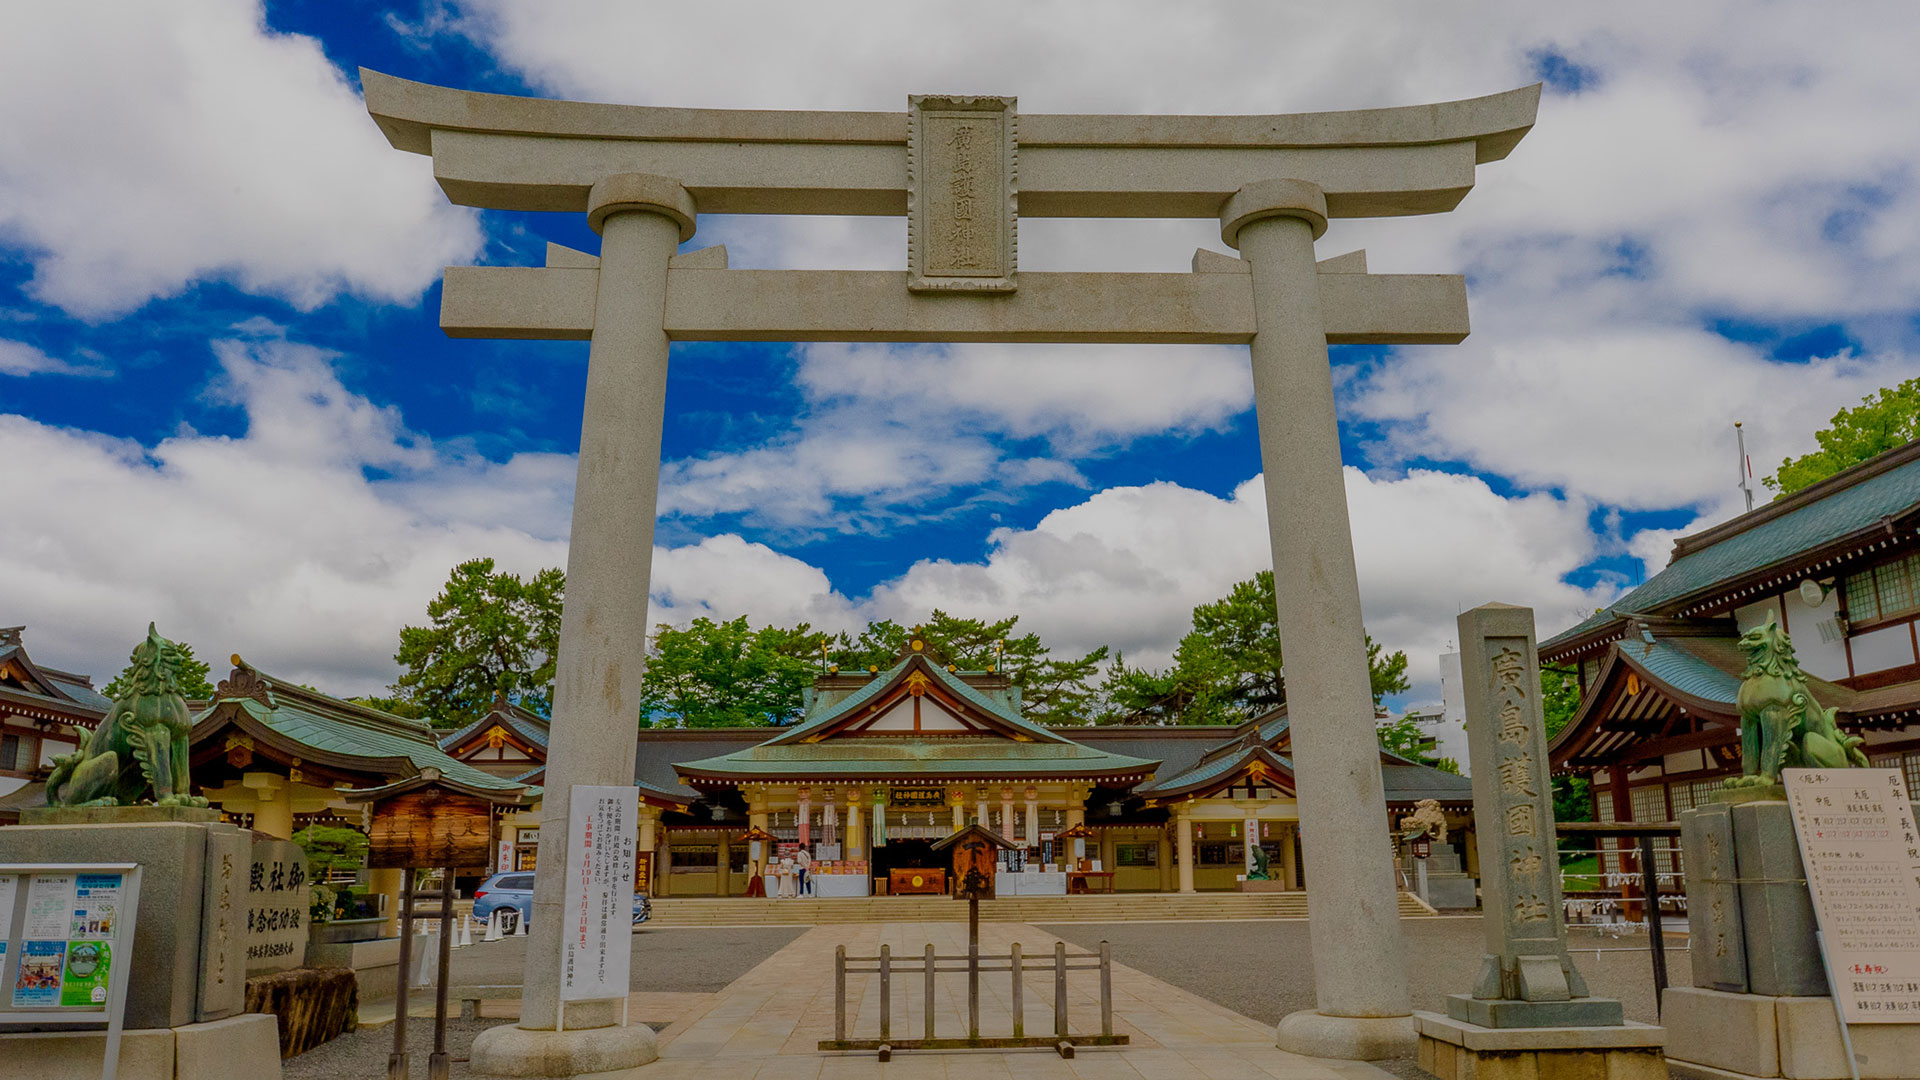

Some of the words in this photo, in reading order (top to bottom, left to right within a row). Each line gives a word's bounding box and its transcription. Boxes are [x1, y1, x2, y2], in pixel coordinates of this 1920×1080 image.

[948, 126, 977, 267] 廣島護國神社
[1489, 646, 1550, 924] 廣島護國神社
[622, 836, 632, 882] お知らせ
